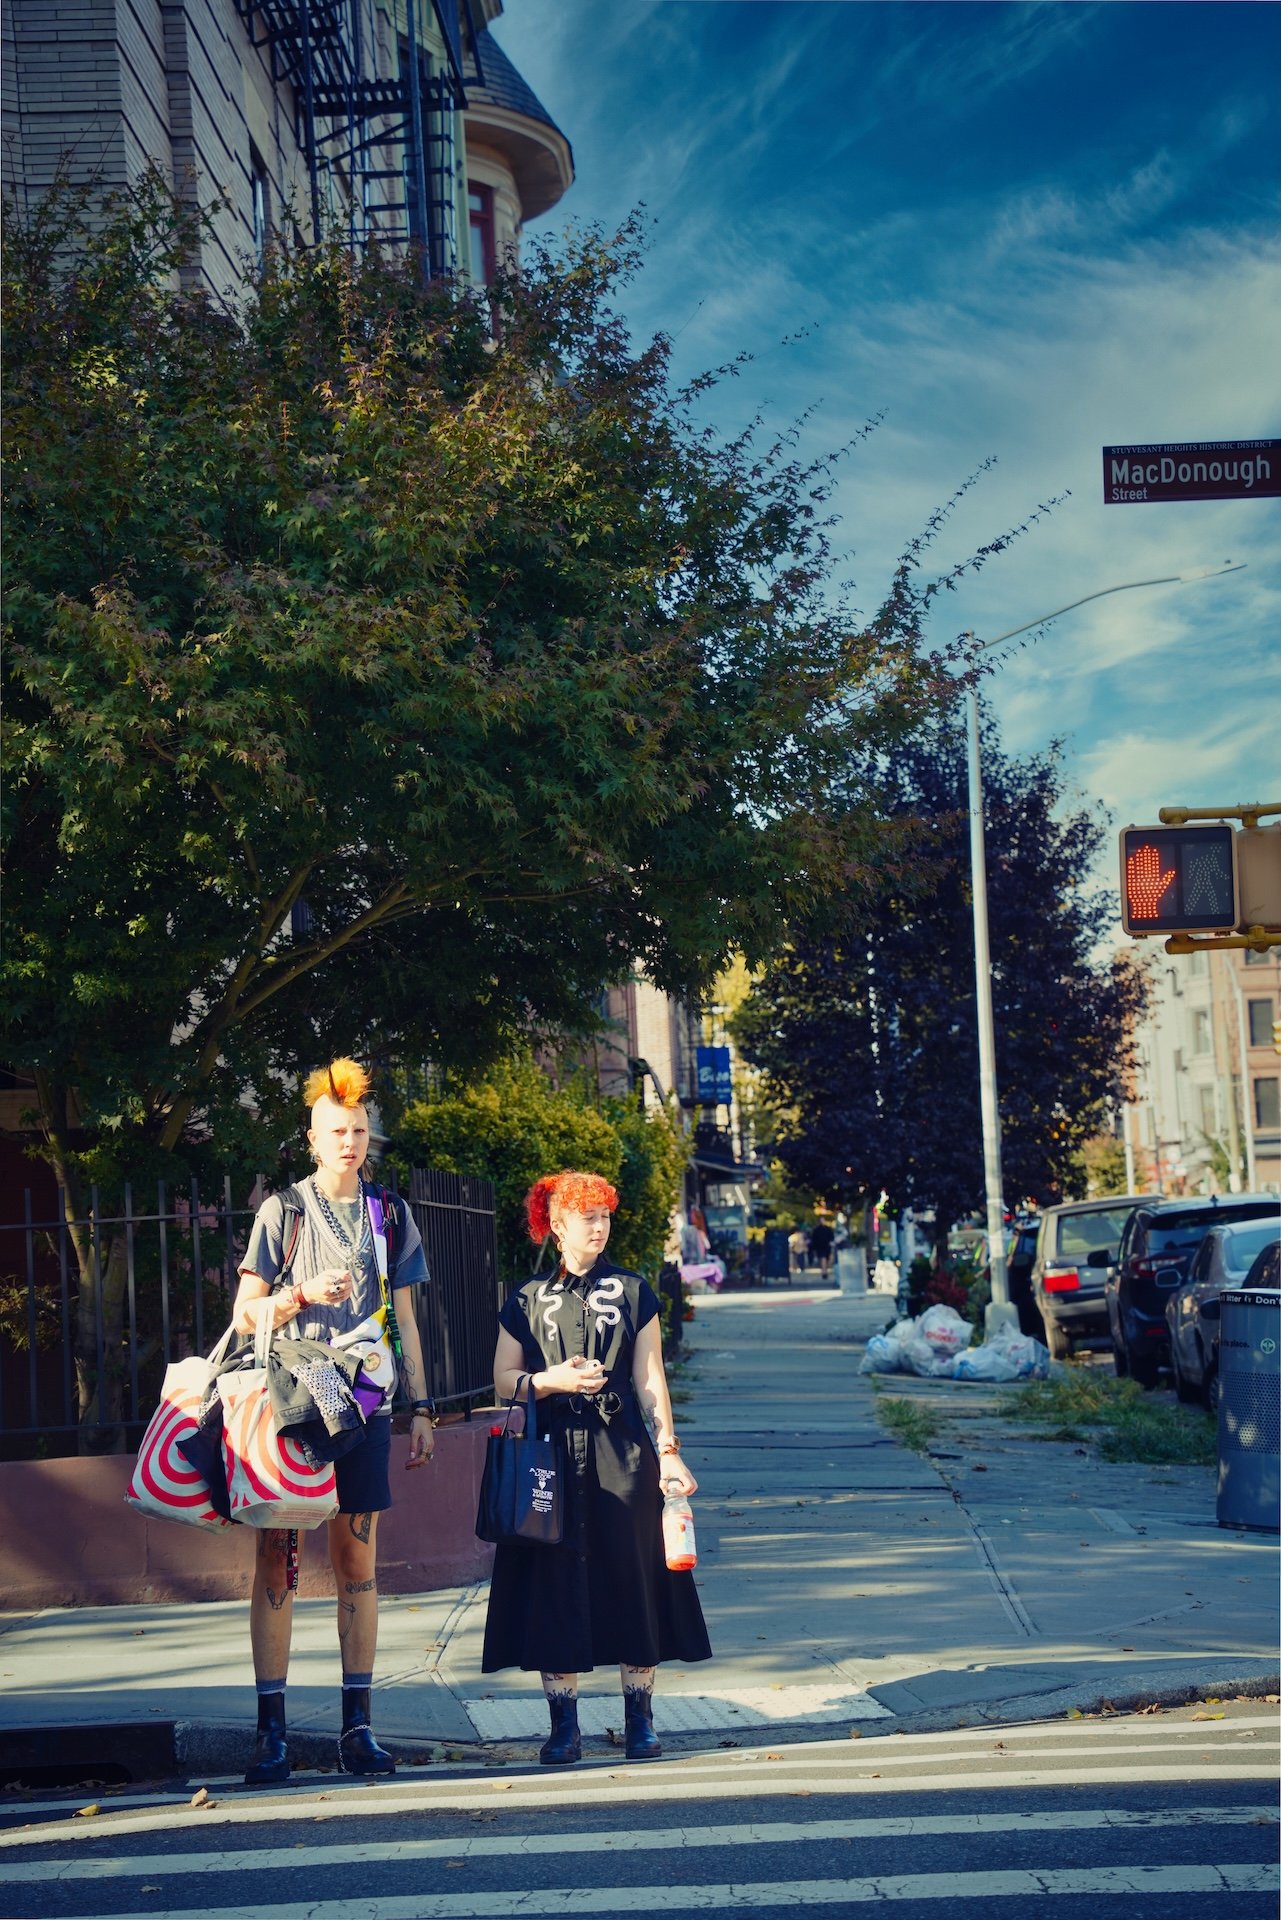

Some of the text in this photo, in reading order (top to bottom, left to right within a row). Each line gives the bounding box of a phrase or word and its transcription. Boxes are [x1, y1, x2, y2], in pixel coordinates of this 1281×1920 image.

[1112, 441, 1273, 454] STUYVESANT HEIGHTS HISTORIC DISTRICT
[1111, 454, 1271, 489] MacDonough
[1111, 487, 1148, 500] Street
[532, 1488, 553, 1496] WINE
